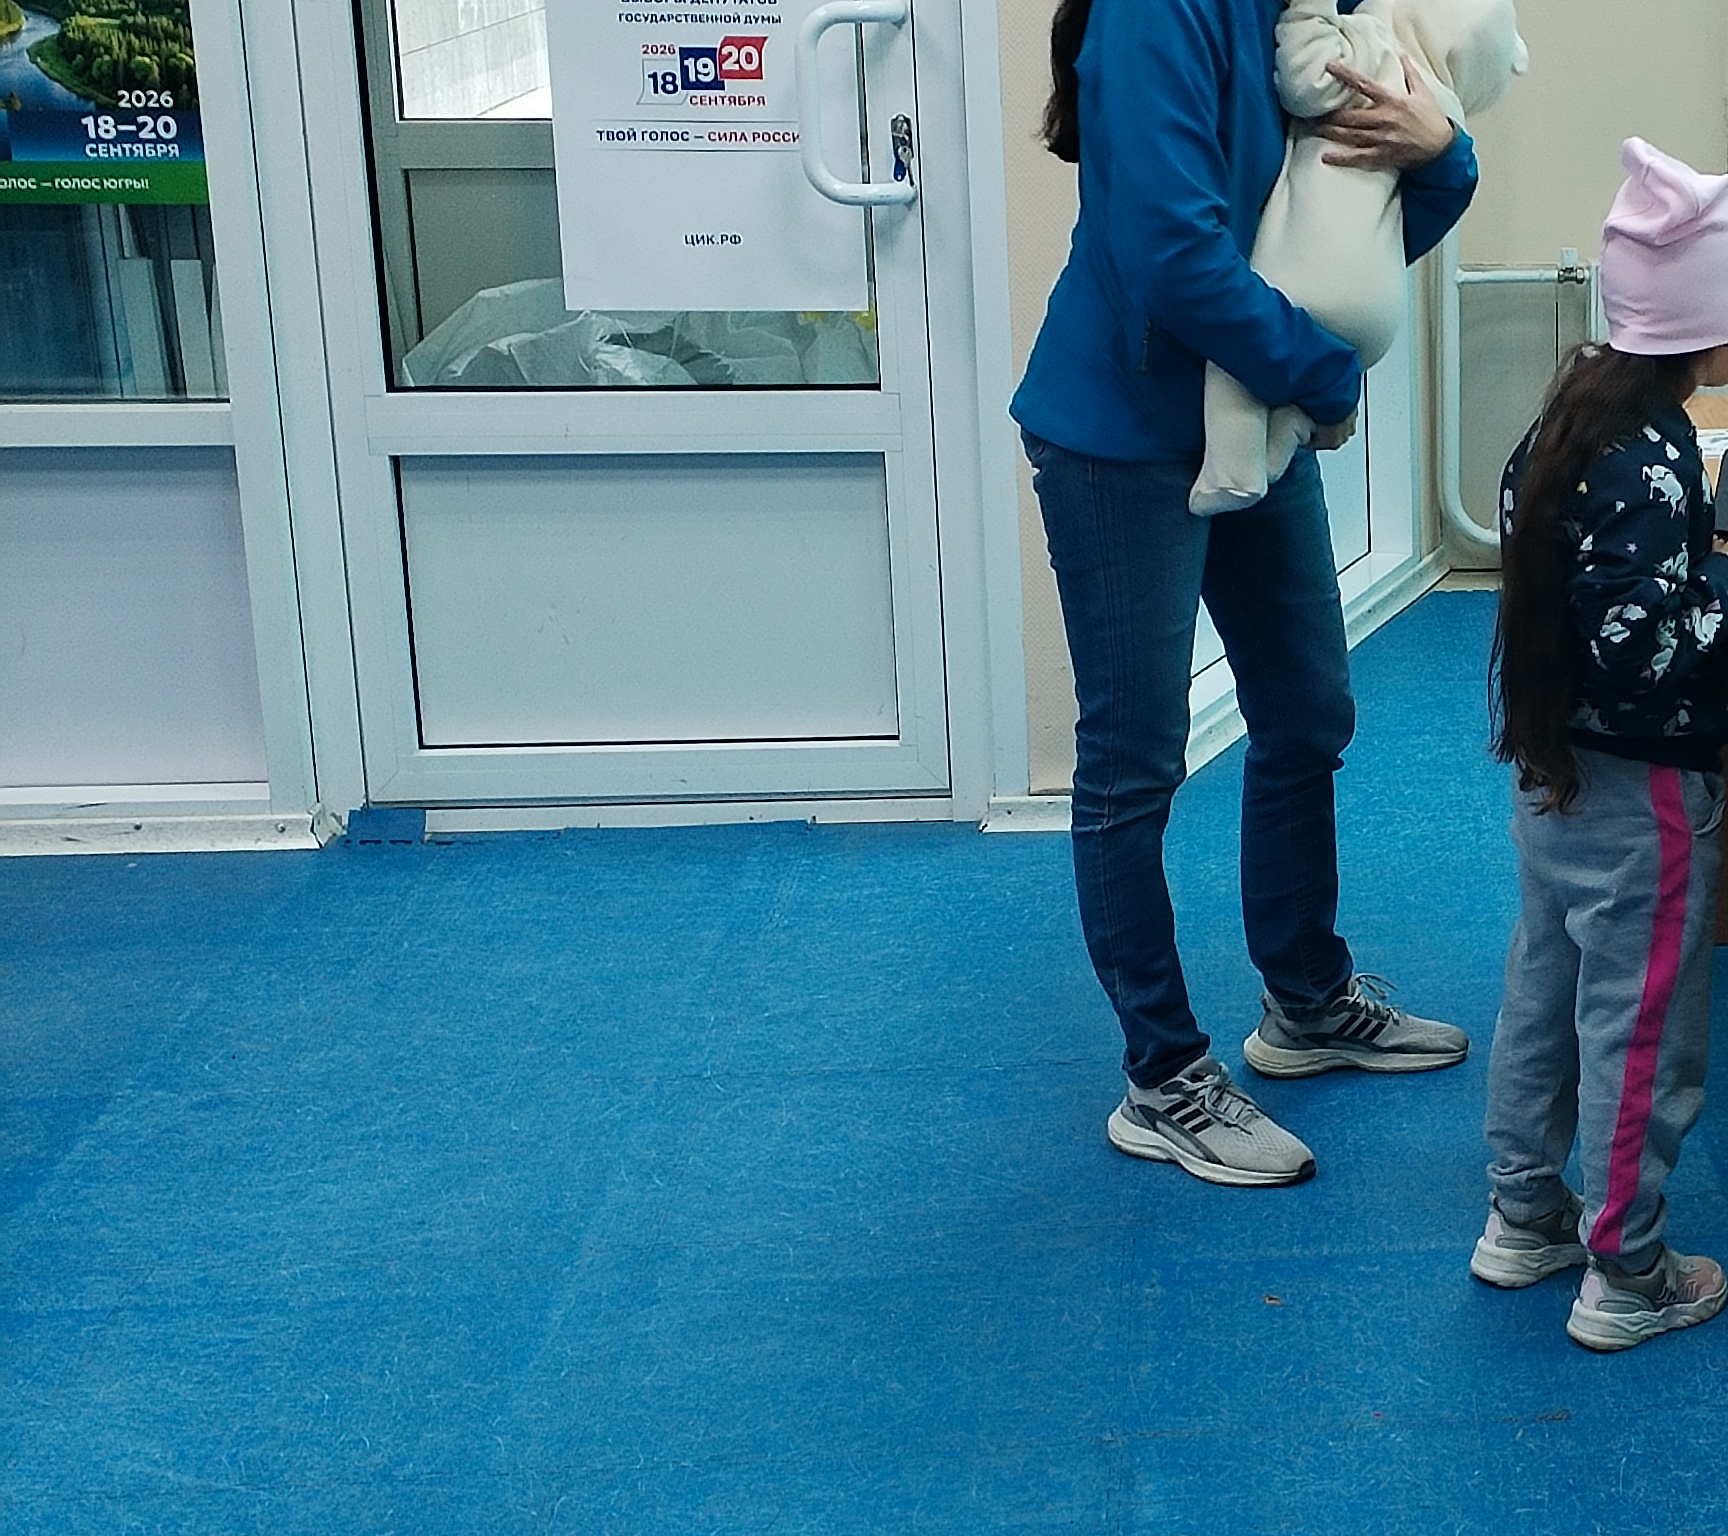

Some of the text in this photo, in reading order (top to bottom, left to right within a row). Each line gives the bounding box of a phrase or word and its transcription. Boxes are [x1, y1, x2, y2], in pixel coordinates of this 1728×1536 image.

[618, 11, 782, 26] ГОСУДАРСТВЕННОЙ ДУМЫ
[641, 44, 676, 56] 2026
[647, 45, 759, 95] 18 19 20
[117, 90, 174, 108] 2026
[688, 94, 766, 107] СЕНТЯБРЯ
[596, 128, 638, 143] ТВОЙ
[640, 130, 690, 143] ГОЛОС
[707, 130, 748, 143] СИЛА
[85, 143, 180, 158] СЕНТЯБРЯ
[54, 177, 100, 190] ГОЛОС
[103, 178, 149, 191] ЮГРЫ!
[684, 233, 742, 247] ЦИК.РФ
